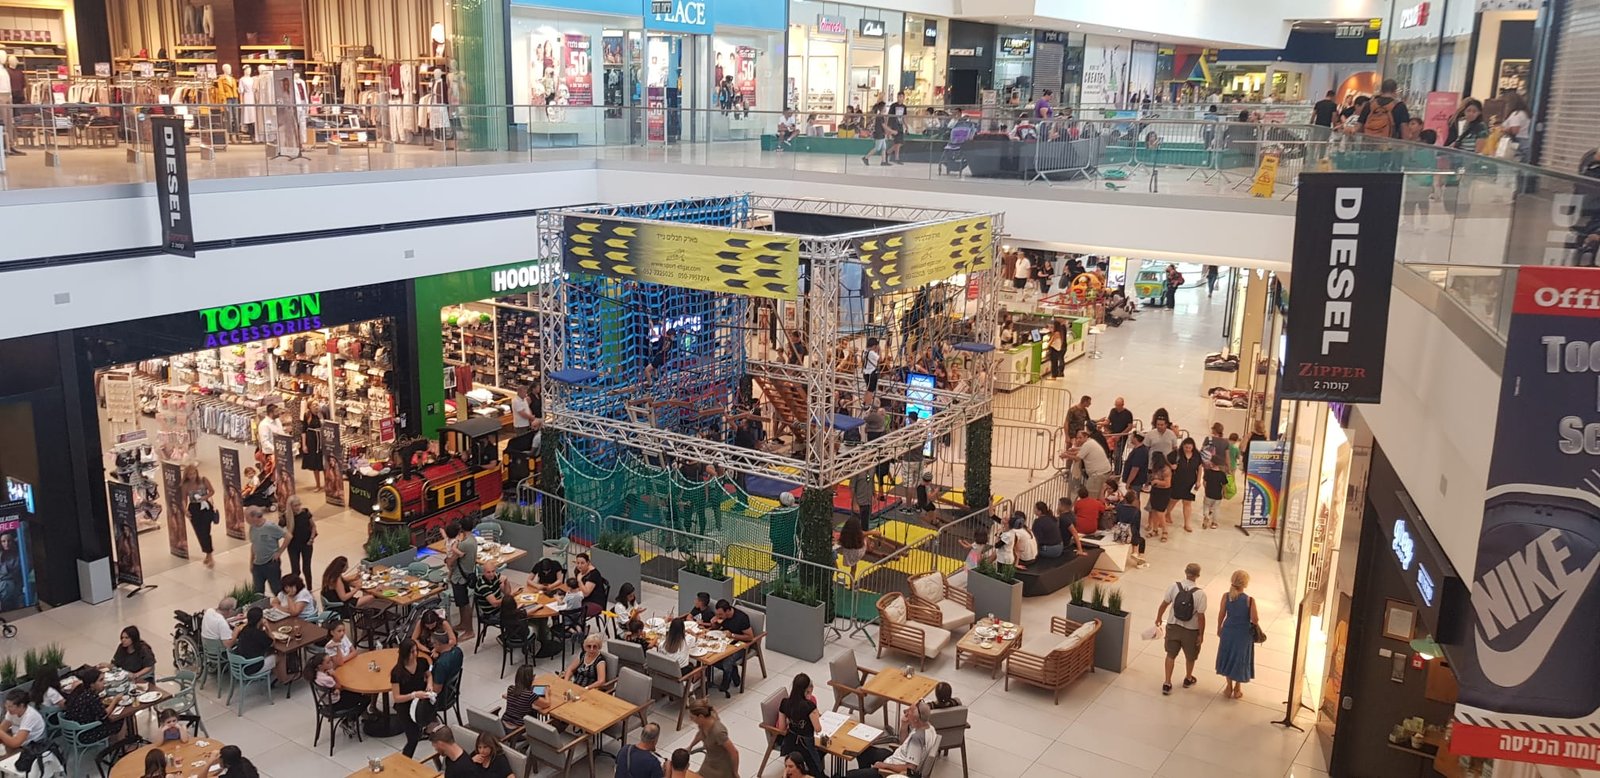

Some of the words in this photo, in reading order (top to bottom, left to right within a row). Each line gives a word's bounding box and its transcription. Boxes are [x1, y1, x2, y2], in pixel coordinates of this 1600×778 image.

[570, 51, 588, 76] 50
[742, 60, 754, 81] 50
[163, 126, 181, 227] DIESEL
[1321, 187, 1364, 355] DIESEL
[206, 316, 322, 348] ACCESSORIES
[1314, 380, 1320, 389] 2
[1322, 381, 1350, 392] קומה
[1471, 527, 1582, 641] NIKE
[1499, 734, 1560, 756] הכניסה
